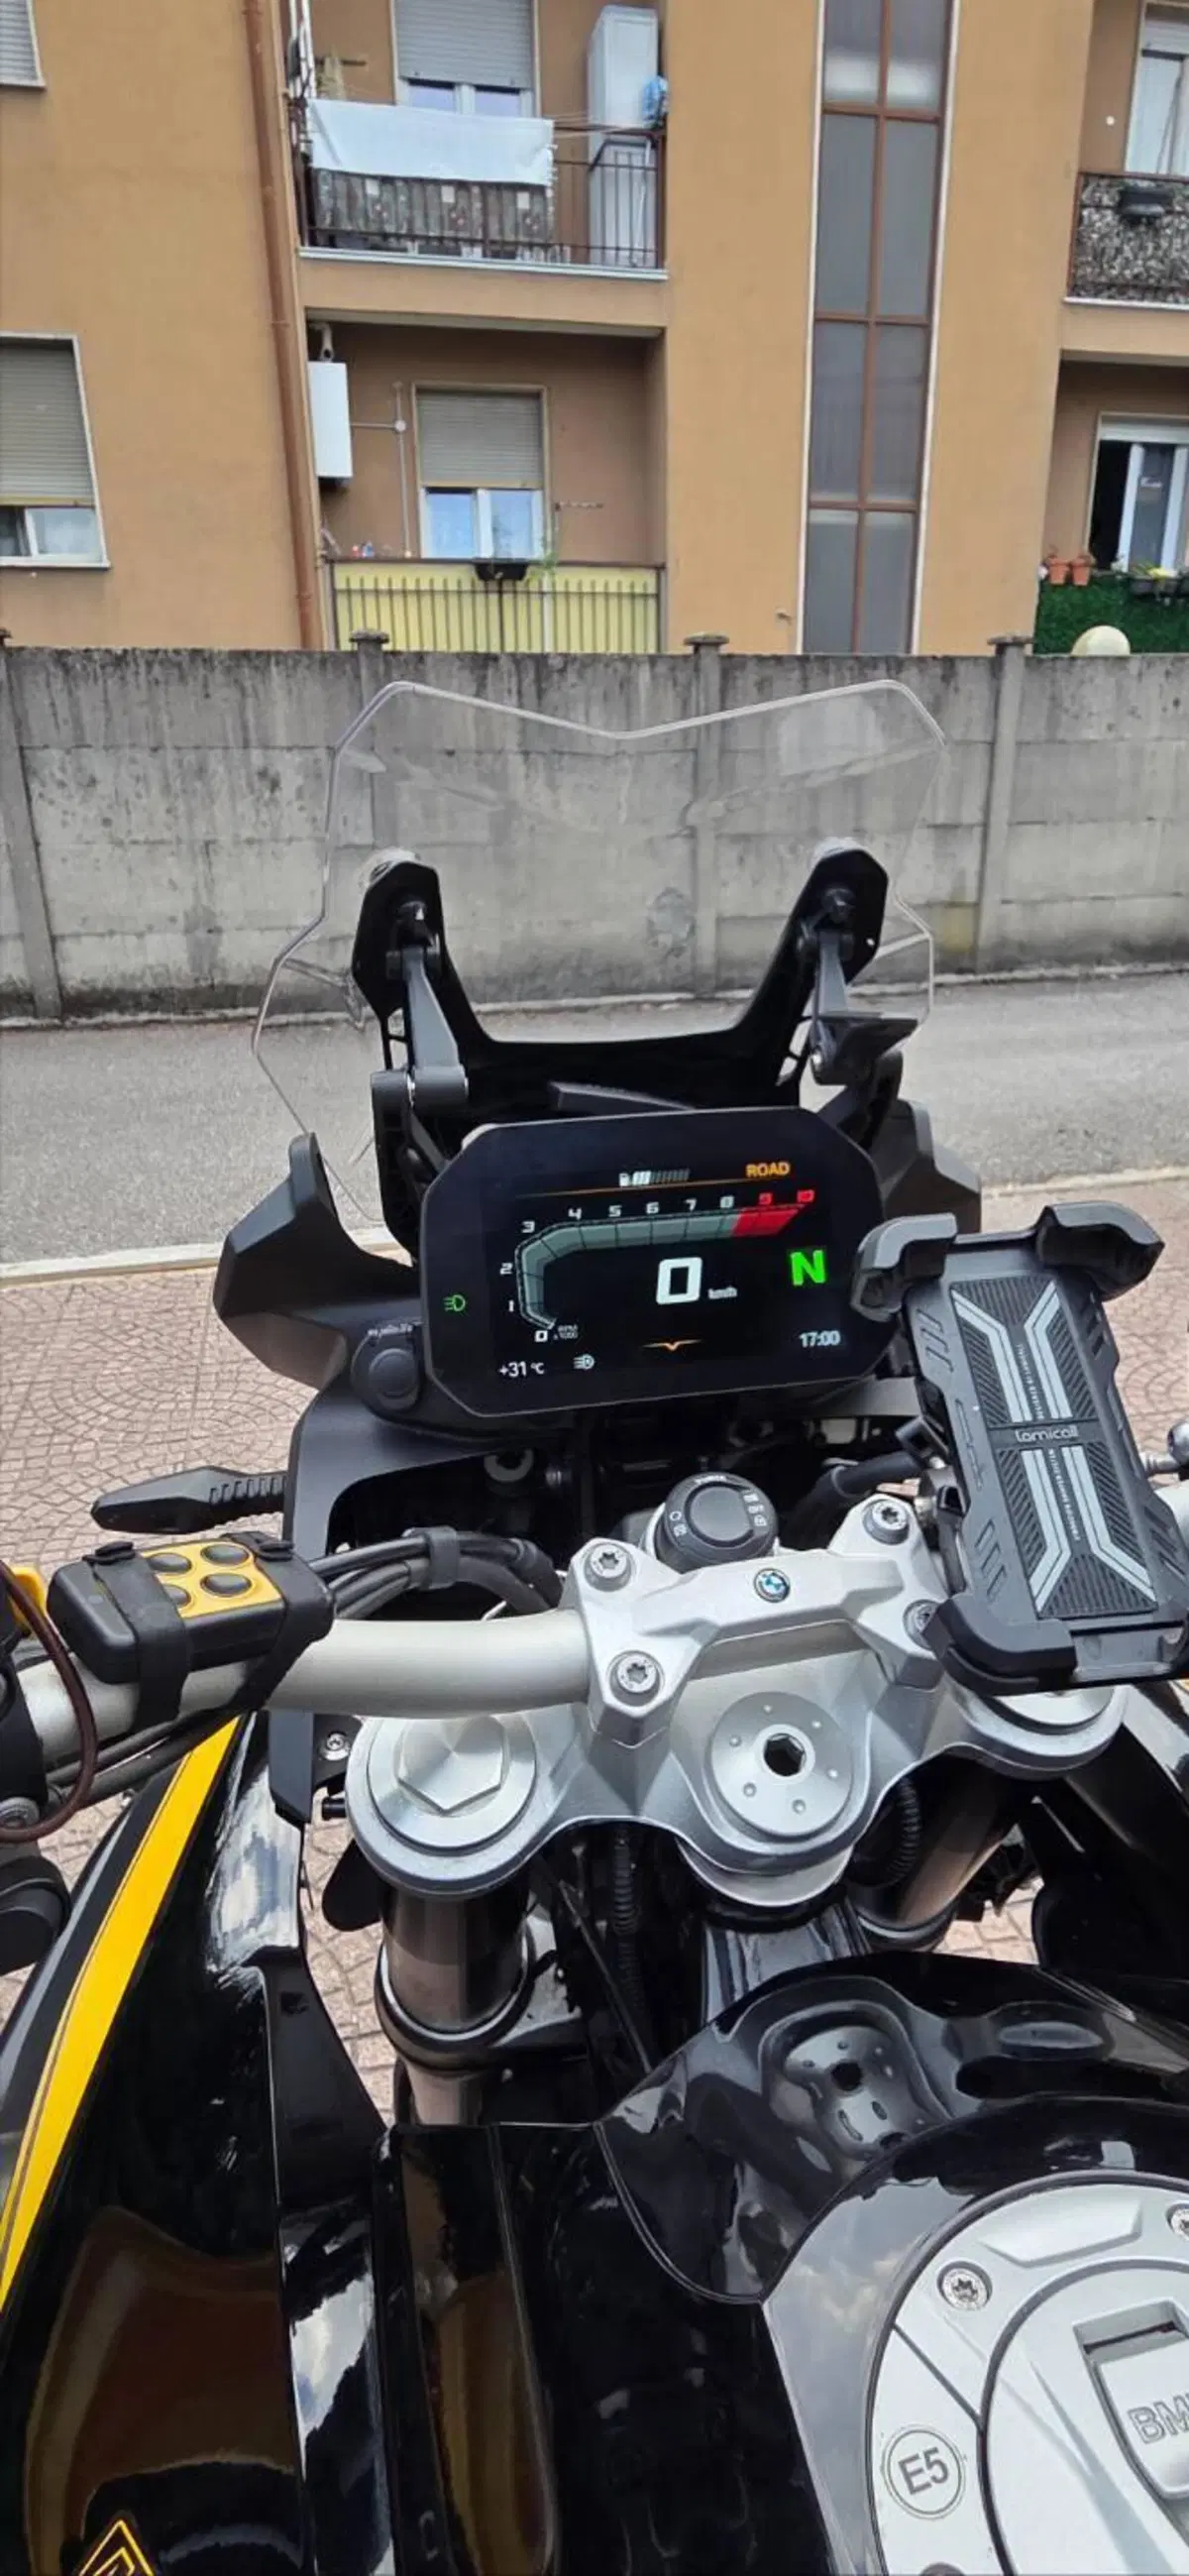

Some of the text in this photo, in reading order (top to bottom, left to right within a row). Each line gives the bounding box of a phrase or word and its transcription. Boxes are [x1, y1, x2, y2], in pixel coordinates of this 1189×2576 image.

[745, 1162, 791, 1177] ROAD
[568, 1207, 582, 1220] 4
[608, 1205, 621, 1217] 5
[646, 1201, 659, 1214] 6
[686, 1198, 697, 1210] 7
[720, 1195, 734, 1208] 8
[521, 1220, 535, 1233] 3
[499, 1263, 512, 1275] 2
[791, 1250, 826, 1286] N
[656, 1257, 703, 1304] 0
[508, 1299, 514, 1312] 1
[534, 1330, 548, 1342] 0
[800, 1330, 841, 1348] 17:00
[499, 1361, 527, 1378] +31
[1127, 2393, 1189, 2445] BM
[898, 2446, 948, 2496] E5
